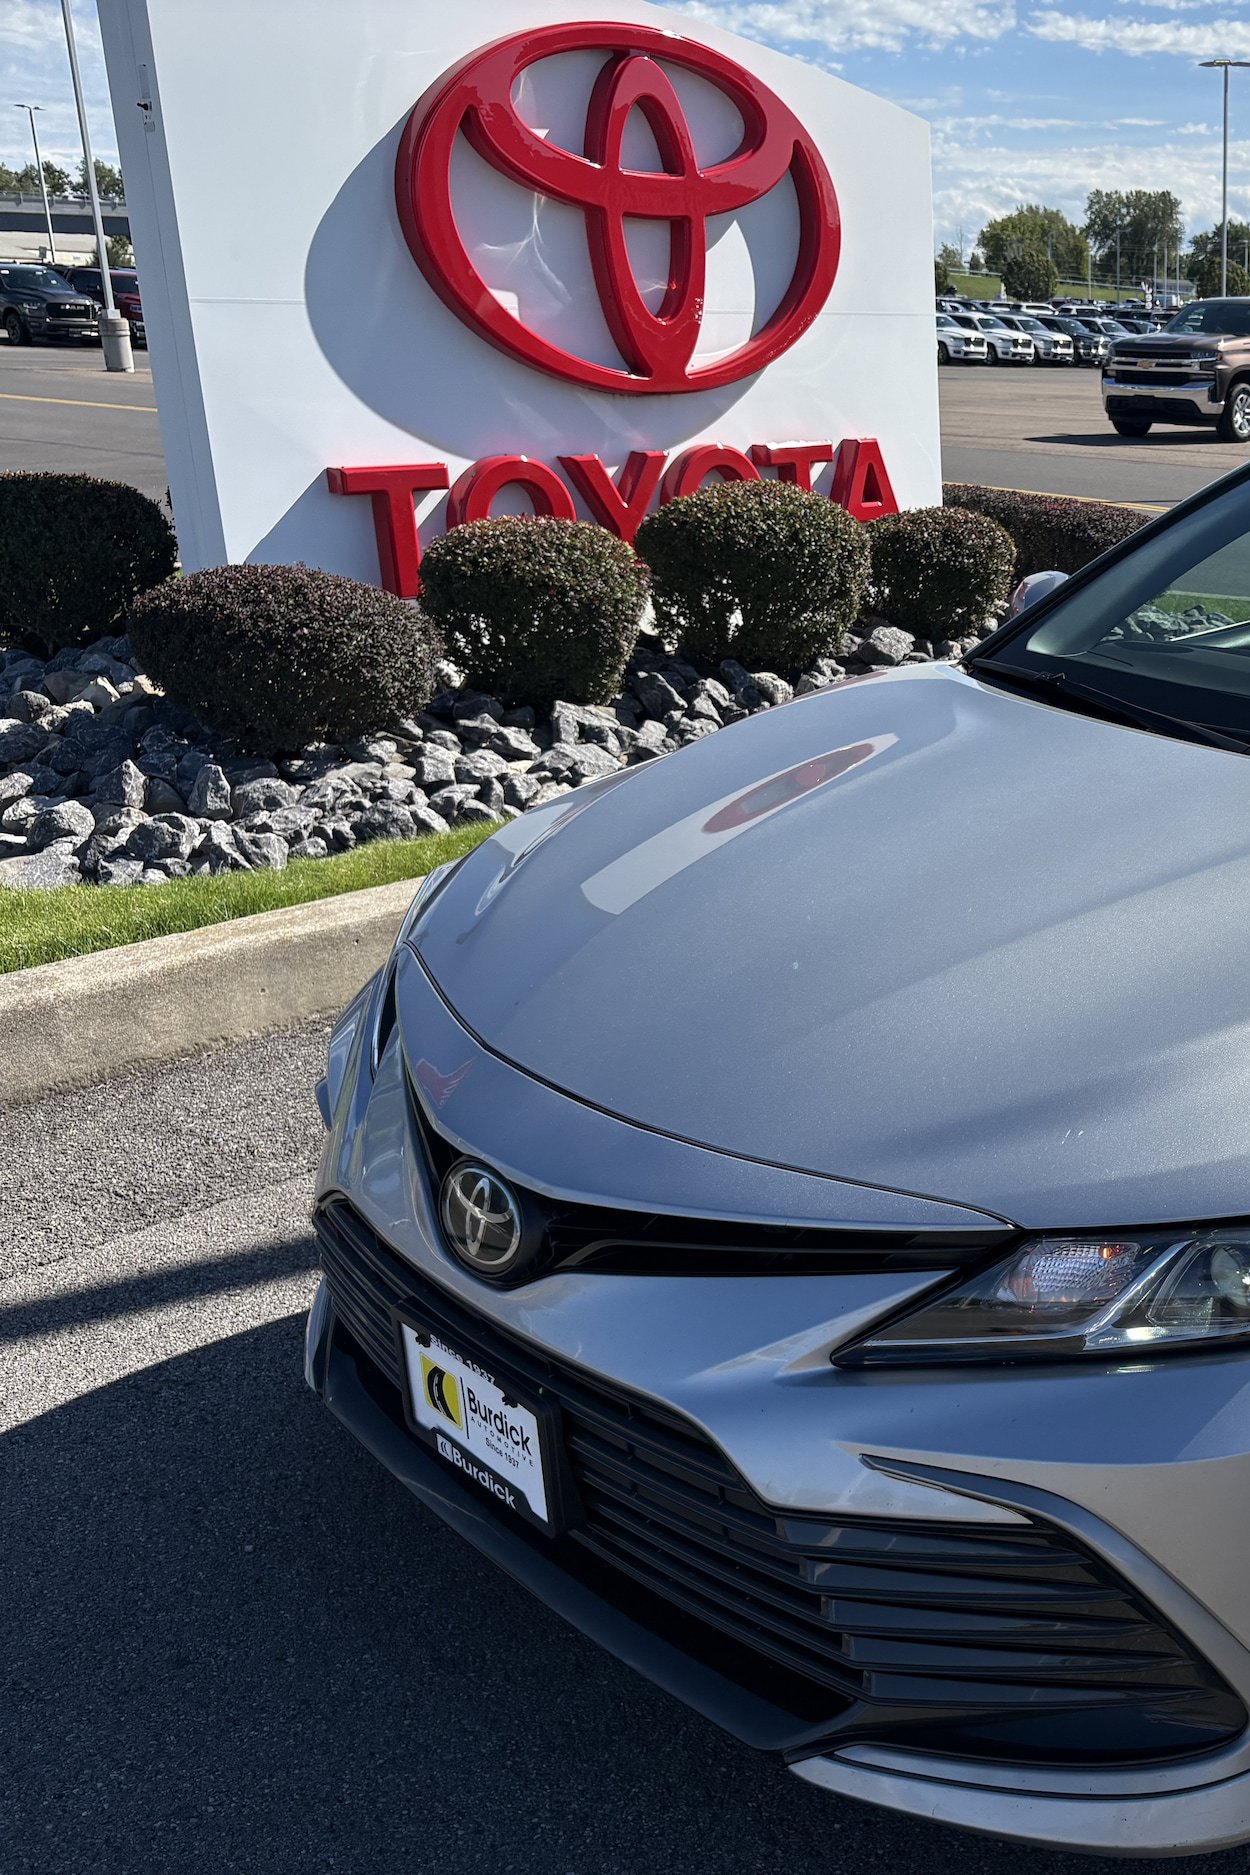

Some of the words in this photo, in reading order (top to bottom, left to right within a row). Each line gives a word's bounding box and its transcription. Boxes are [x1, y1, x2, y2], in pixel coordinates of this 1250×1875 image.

[430, 1333, 463, 1364] Since
[465, 1359, 496, 1385] 1937
[467, 1387, 532, 1456] Burdick
[471, 1416, 534, 1467] AUTOMOTIVE
[452, 1446, 517, 1510] Burdick
[485, 1438, 504, 1457] Since
[504, 1452, 520, 1469] 1937
